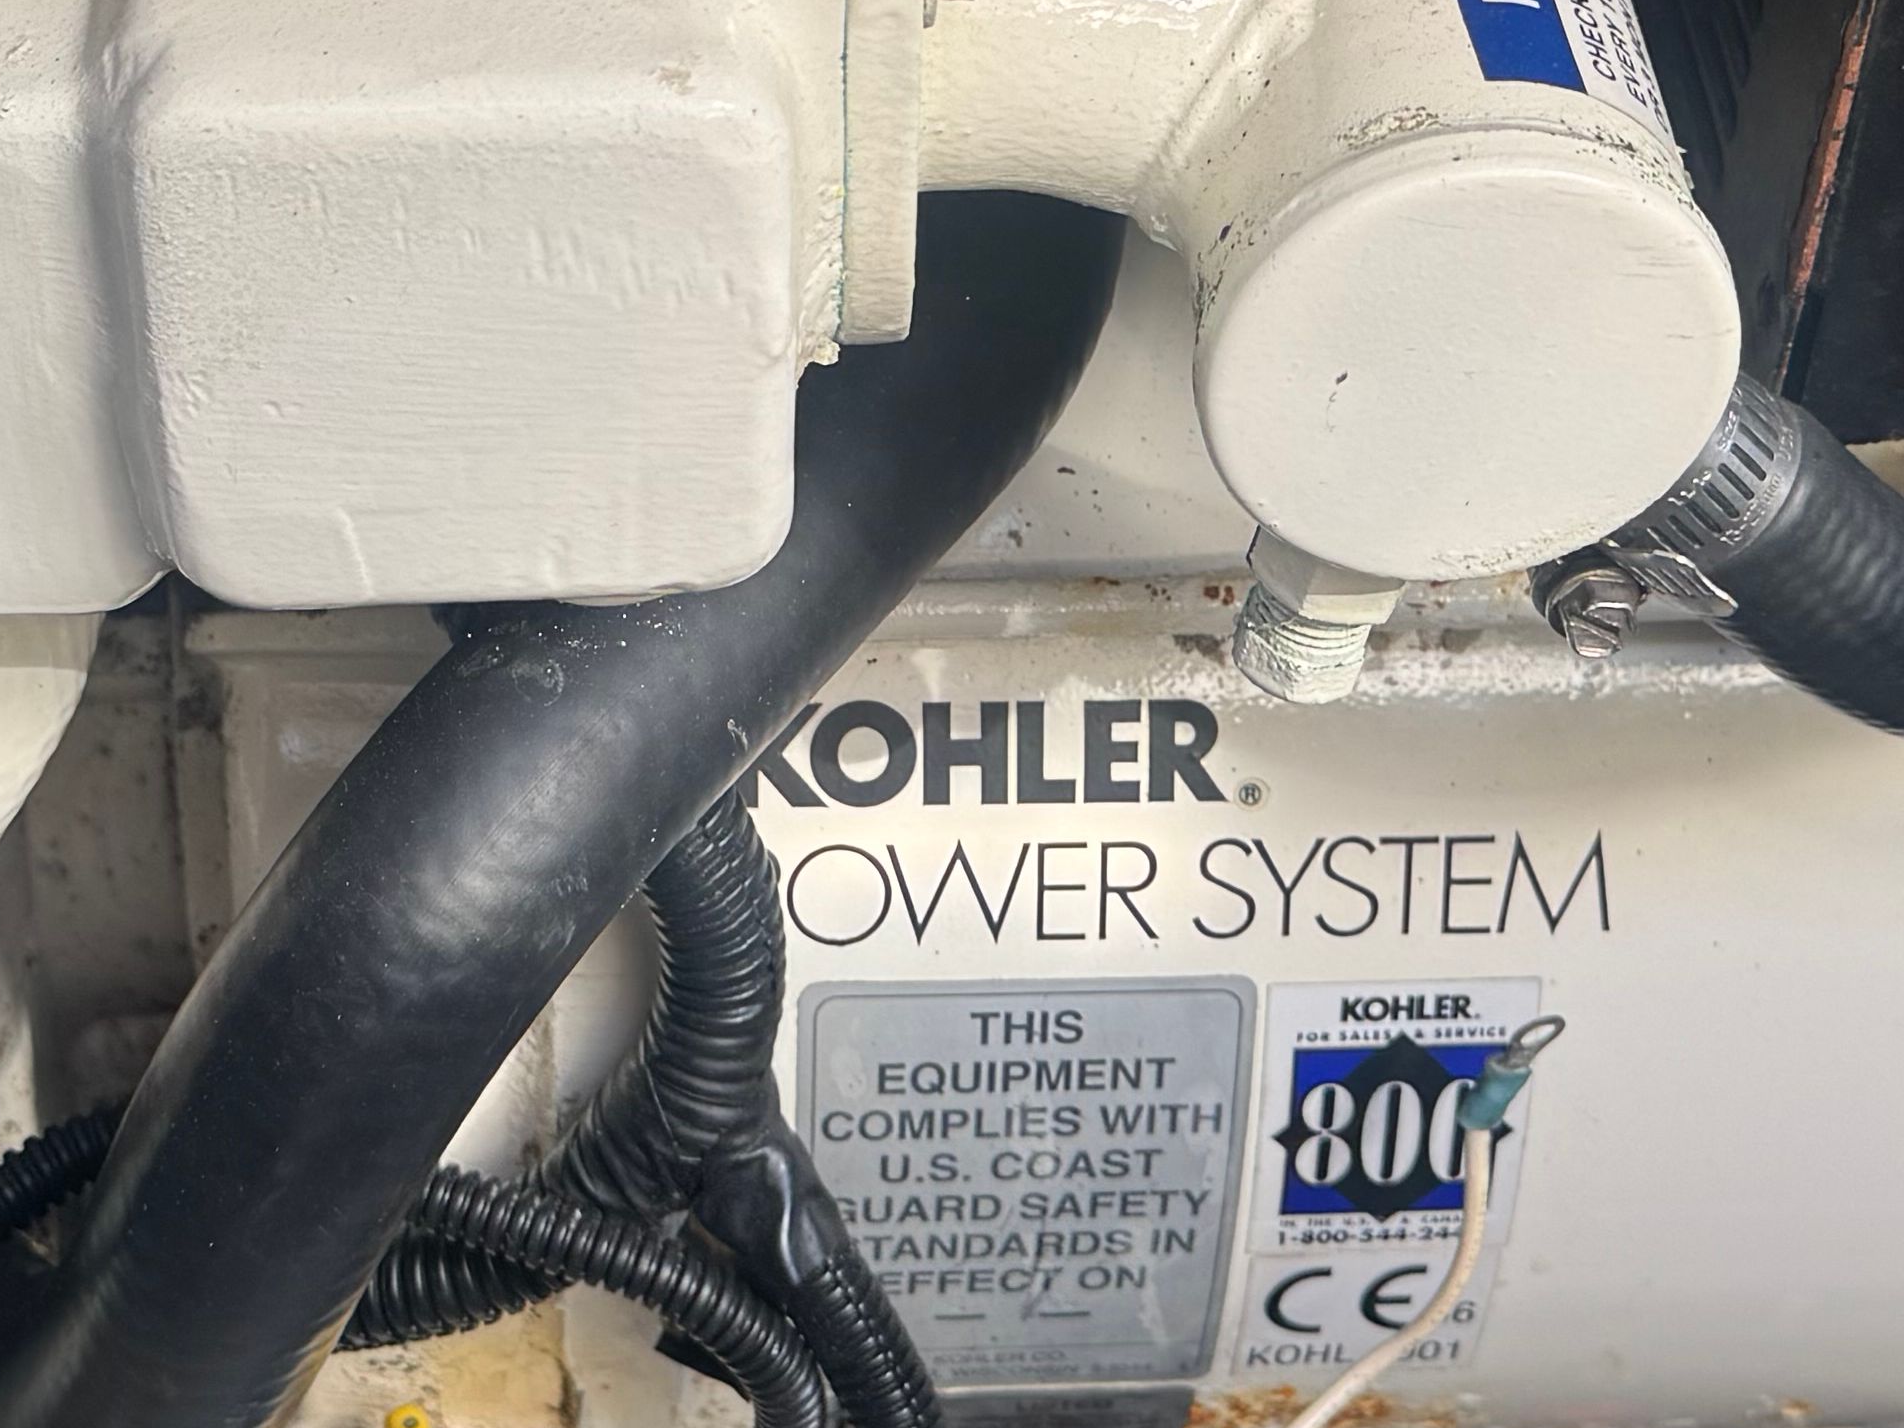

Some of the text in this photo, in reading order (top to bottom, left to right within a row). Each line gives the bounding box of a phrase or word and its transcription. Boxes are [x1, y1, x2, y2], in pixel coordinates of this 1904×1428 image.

[1602, 14, 1648, 108] EVERY
[746, 698, 1231, 809] KOHLER
[787, 829, 1613, 946] OWER SYSTEM
[1339, 995, 1474, 1023] KOHLER
[970, 1012, 1085, 1046] THIS
[1297, 1031, 1331, 1043] FOR
[1338, 1030, 1392, 1042] SALES
[1433, 1026, 1507, 1039] SERVICE
[876, 1057, 1177, 1097] EQUIPMENT
[820, 1101, 1224, 1143] COMPLIES WITH
[880, 1148, 1164, 1183] U.S. COAST
[1018, 1188, 1211, 1221] SAFETY
[1149, 1227, 1197, 1256] IN
[1277, 1226, 1463, 1245] 1-800-544-24
[1077, 1266, 1146, 1290] ON
